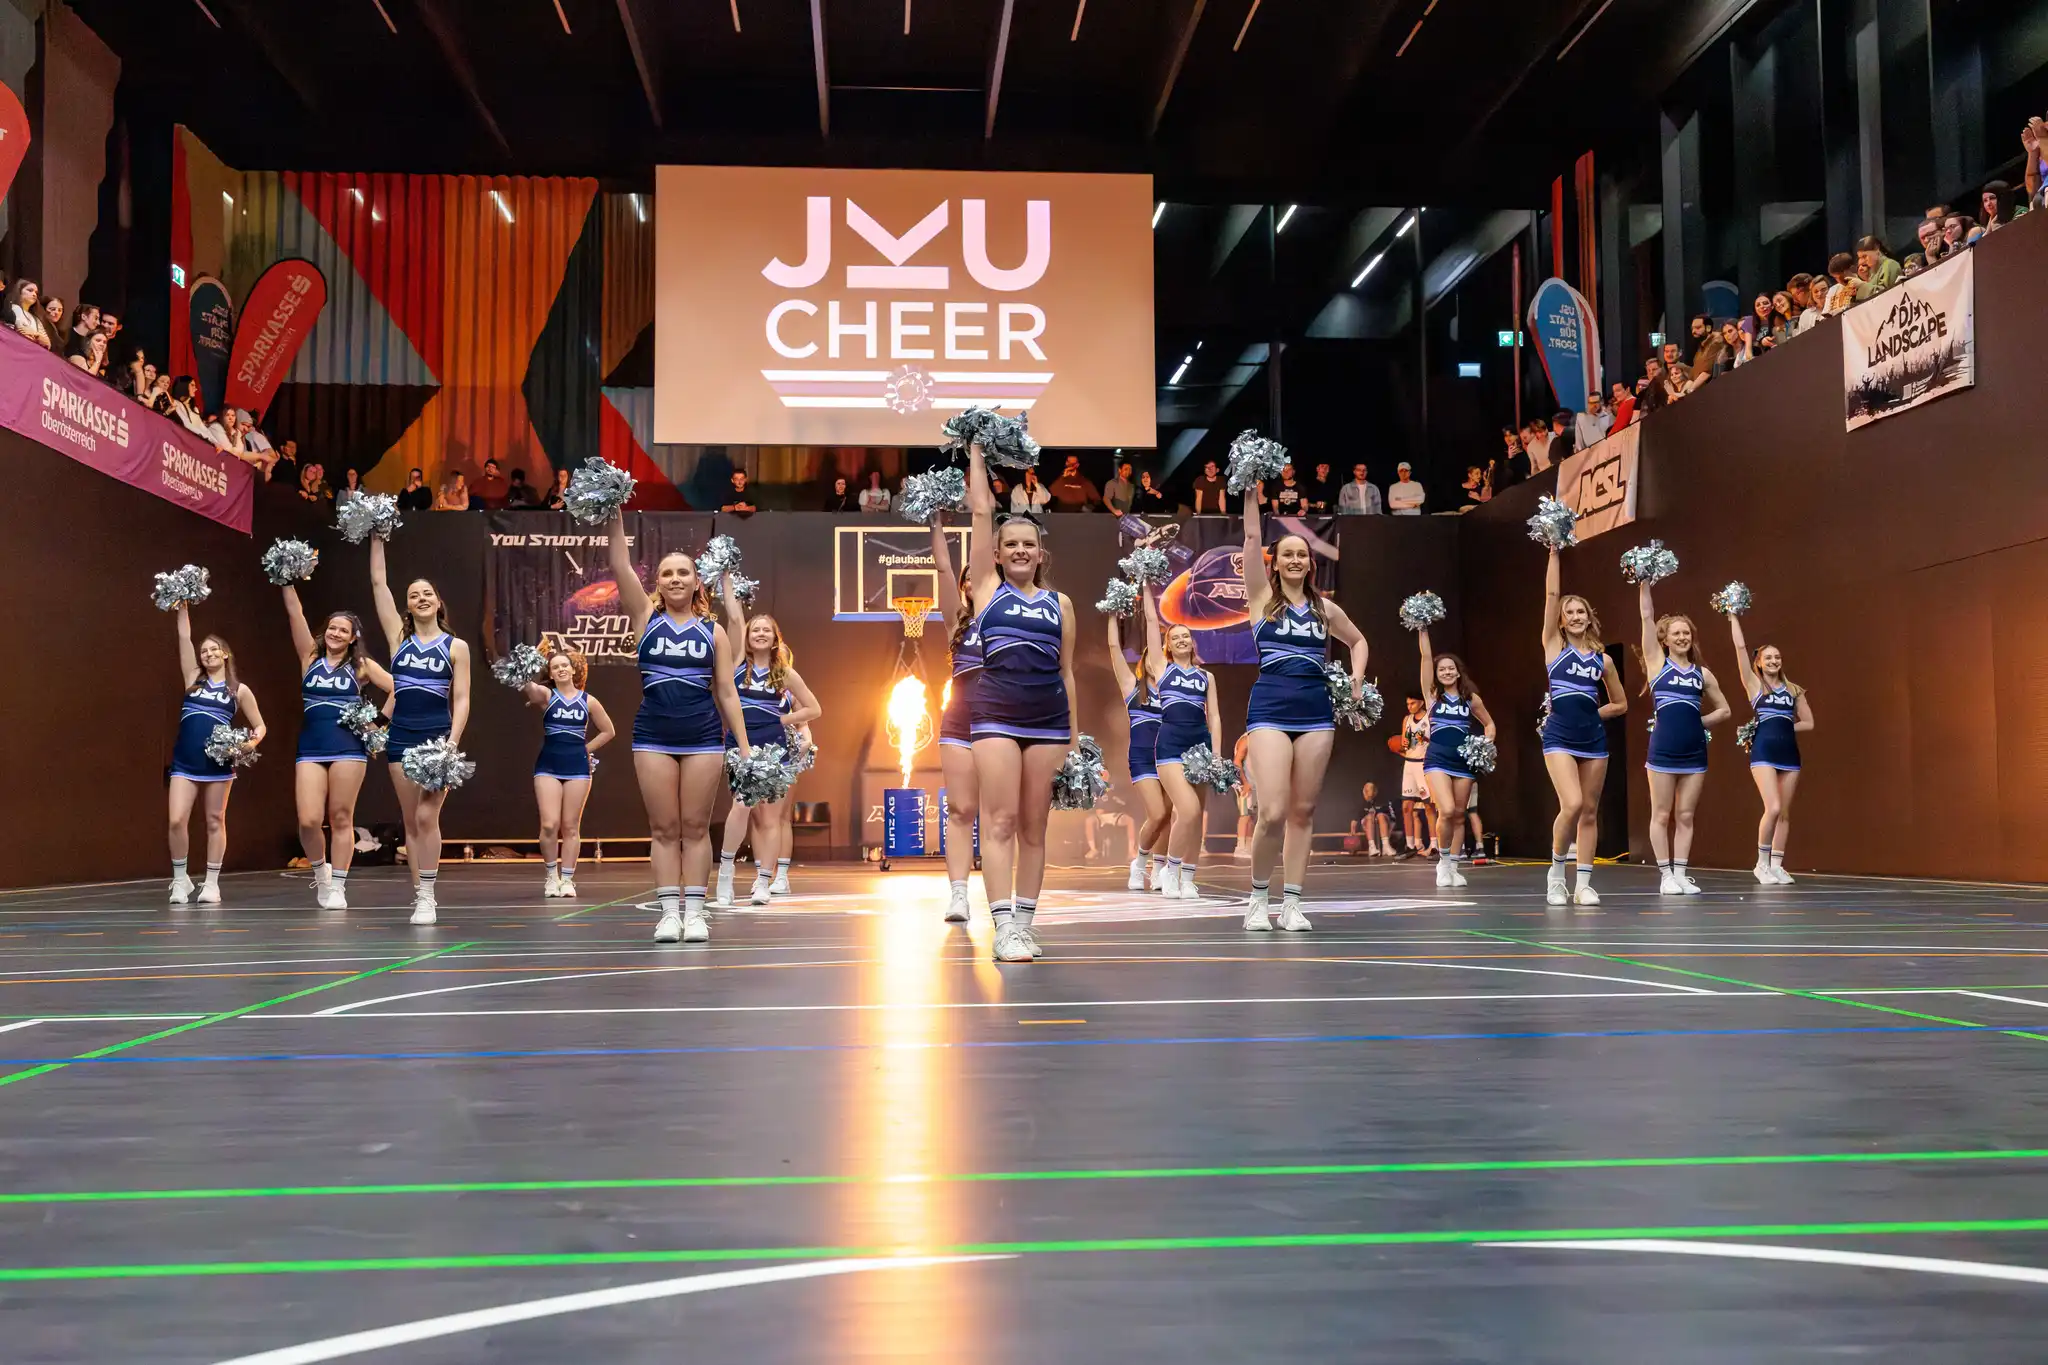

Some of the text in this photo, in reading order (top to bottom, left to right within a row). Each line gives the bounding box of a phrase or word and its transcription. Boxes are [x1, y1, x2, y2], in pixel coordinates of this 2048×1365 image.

[765, 299, 1048, 361] CHEER
[1899, 301, 1914, 329] DJ
[237, 291, 301, 387] SPARKASSE
[1868, 312, 1948, 368] LANDSCAPE
[41, 409, 96, 452] Oberösterreich
[42, 377, 117, 442] SPARKASSE
[162, 441, 218, 493] SPARKASSE
[490, 533, 635, 547] YOU STUDY HEE
[878, 554, 936, 567] #glauband
[888, 796, 896, 816] AG
